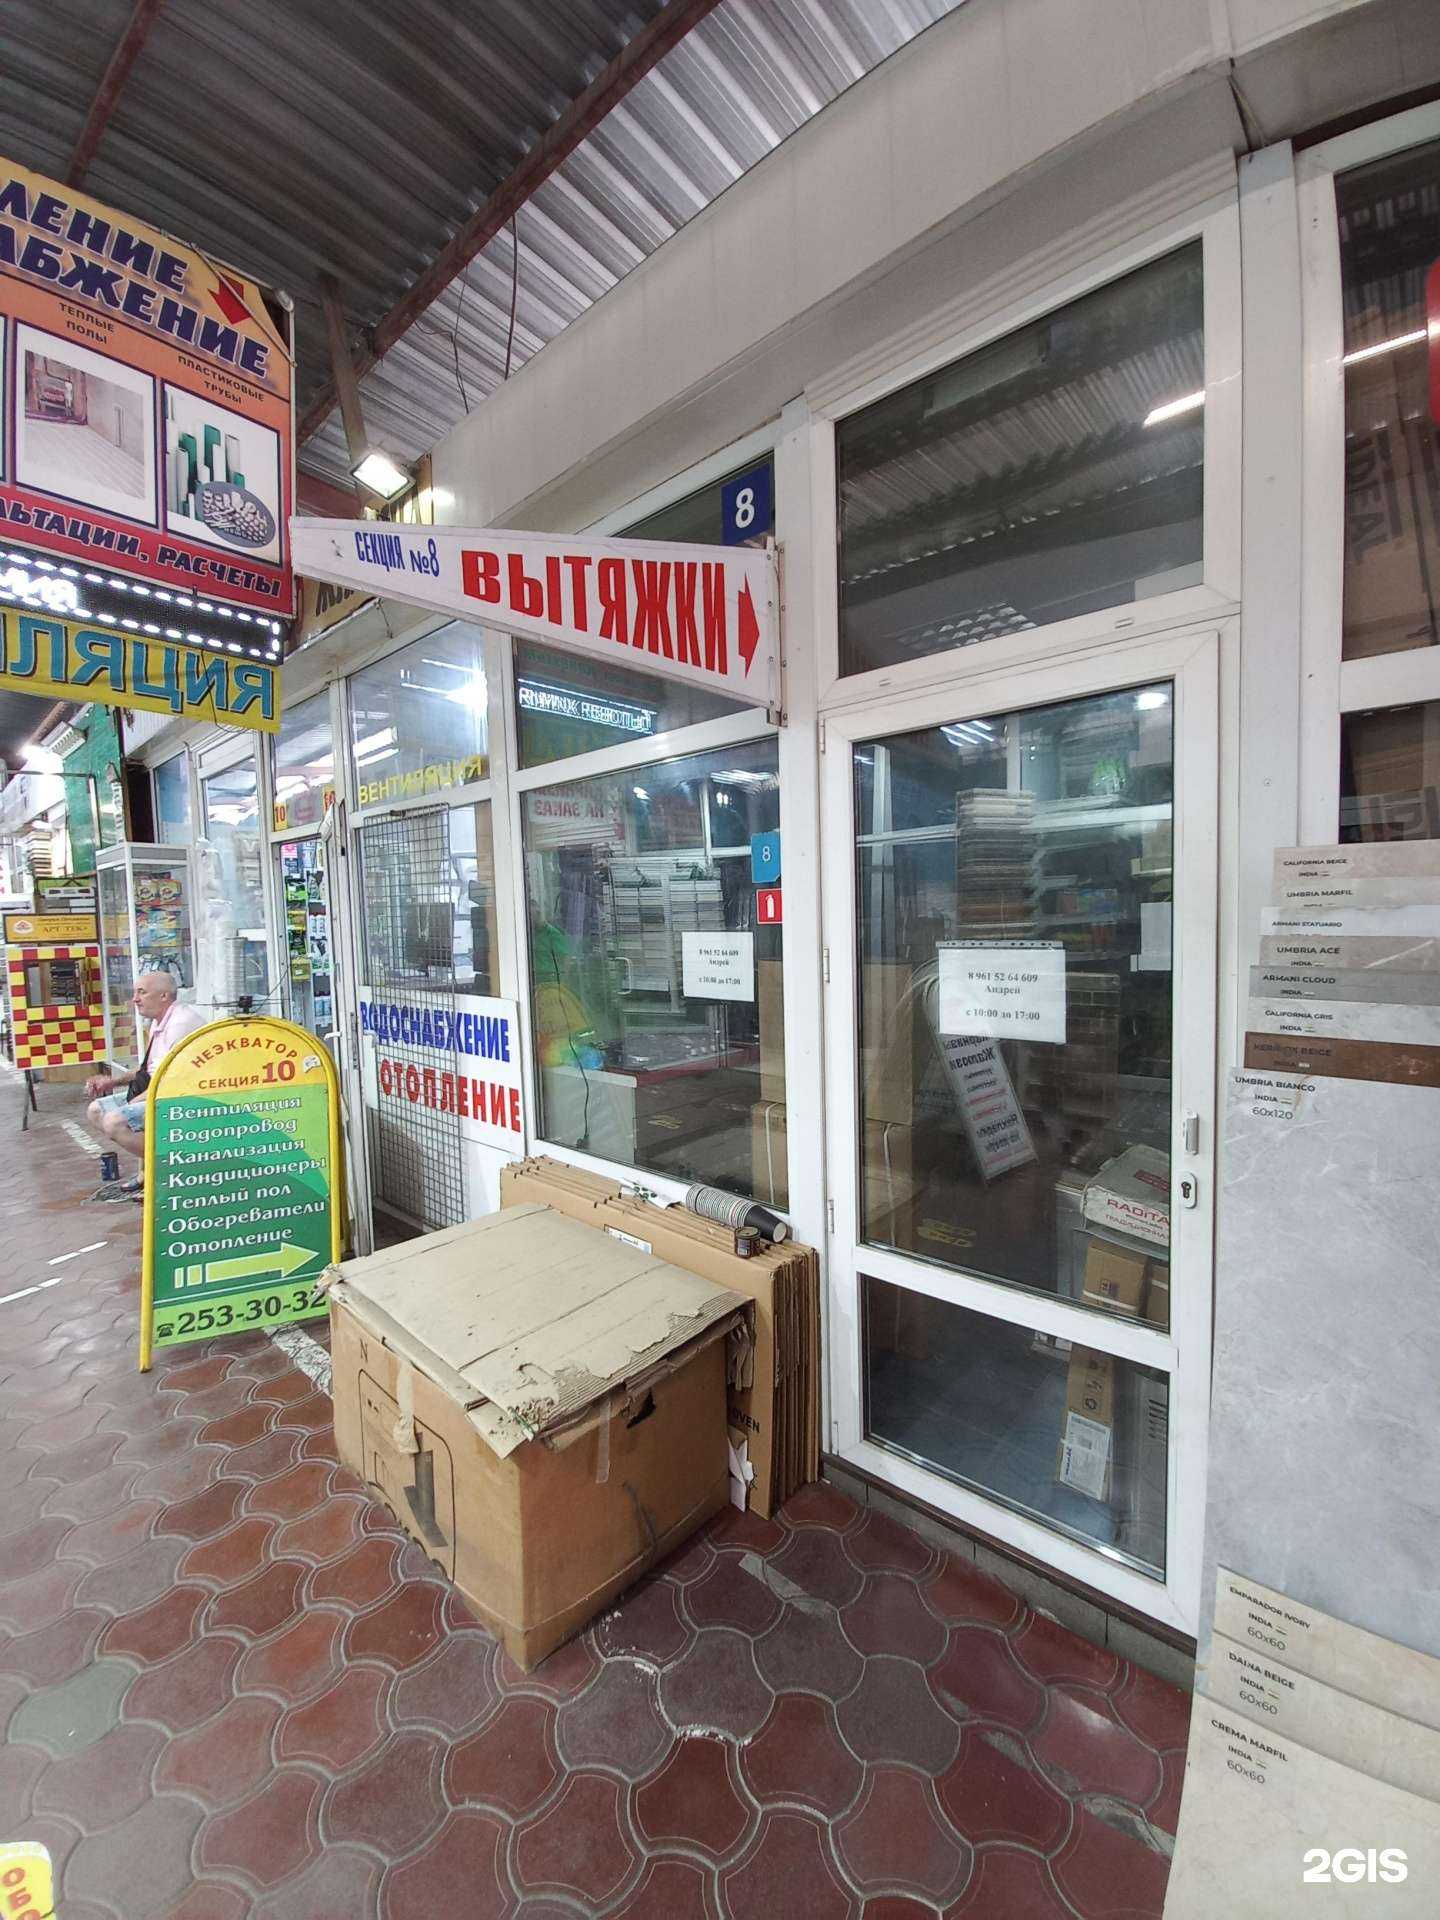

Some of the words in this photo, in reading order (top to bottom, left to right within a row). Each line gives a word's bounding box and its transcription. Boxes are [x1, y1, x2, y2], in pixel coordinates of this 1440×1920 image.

[59, 301, 115, 334] ТЕПЛЫЕ
[66, 320, 108, 345] ПОЛЫ
[178, 355, 264, 402] ПЛАСТИКОВЫЕ
[204, 380, 243, 405] ТРУБЫ
[735, 488, 755, 528] 8
[355, 531, 403, 574] СЕКЦИЯ
[409, 537, 440, 578] №8
[157, 545, 281, 598] РАСЧЕТЫ
[461, 549, 727, 675] ВЫТЯЖКИ
[0, 612, 275, 720] ЛЯЦИЯ
[274, 806, 286, 823] 10
[762, 845, 771, 862] 8
[1286, 890, 1320, 898] UMBRIA
[1321, 889, 1353, 897] MARFIL
[975, 972, 991, 981] 961
[993, 972, 1005, 981] 52
[1007, 972, 1019, 981] 64
[1020, 973, 1038, 982] 609
[1262, 974, 1300, 982] ARMANI
[1302, 976, 1336, 984] CLOUD
[973, 1008, 998, 1018] 10:00
[1014, 1010, 1040, 1020] 17:00
[1265, 1010, 1312, 1019] CALIFORNIA
[360, 1001, 510, 1063] ВОДОСНАБЖЕНИЕ
[191, 1036, 298, 1069] НЕЭКВАТОР
[198, 1075, 260, 1090] СЕКЦИЯ
[261, 1059, 296, 1084] 10
[1235, 1076, 1274, 1087] UMBRIA
[1275, 1081, 1316, 1092] BIANCO
[380, 1058, 521, 1133] ОТОПЛЕНИЕ
[1255, 1094, 1279, 1102] INDIA
[1252, 1106, 1293, 1120] 60x120
[256, 1184, 291, 1199] пол
[1229, 1586, 1282, 1615] EMPARADOR
[1284, 1612, 1311, 1629] IVORY
[1248, 1612, 1273, 1628] INDIA
[1247, 1626, 1286, 1651] 60x60
[1240, 1675, 1265, 1691] INDIA
[1264, 1669, 1295, 1690] BEIGE
[1239, 1690, 1278, 1715] 60x60
[1211, 1719, 1247, 1742] CREMA
[1249, 1738, 1288, 1762] MARFIL
[1228, 1745, 1253, 1762] INDIA
[1226, 1759, 1266, 1785] 60x60
